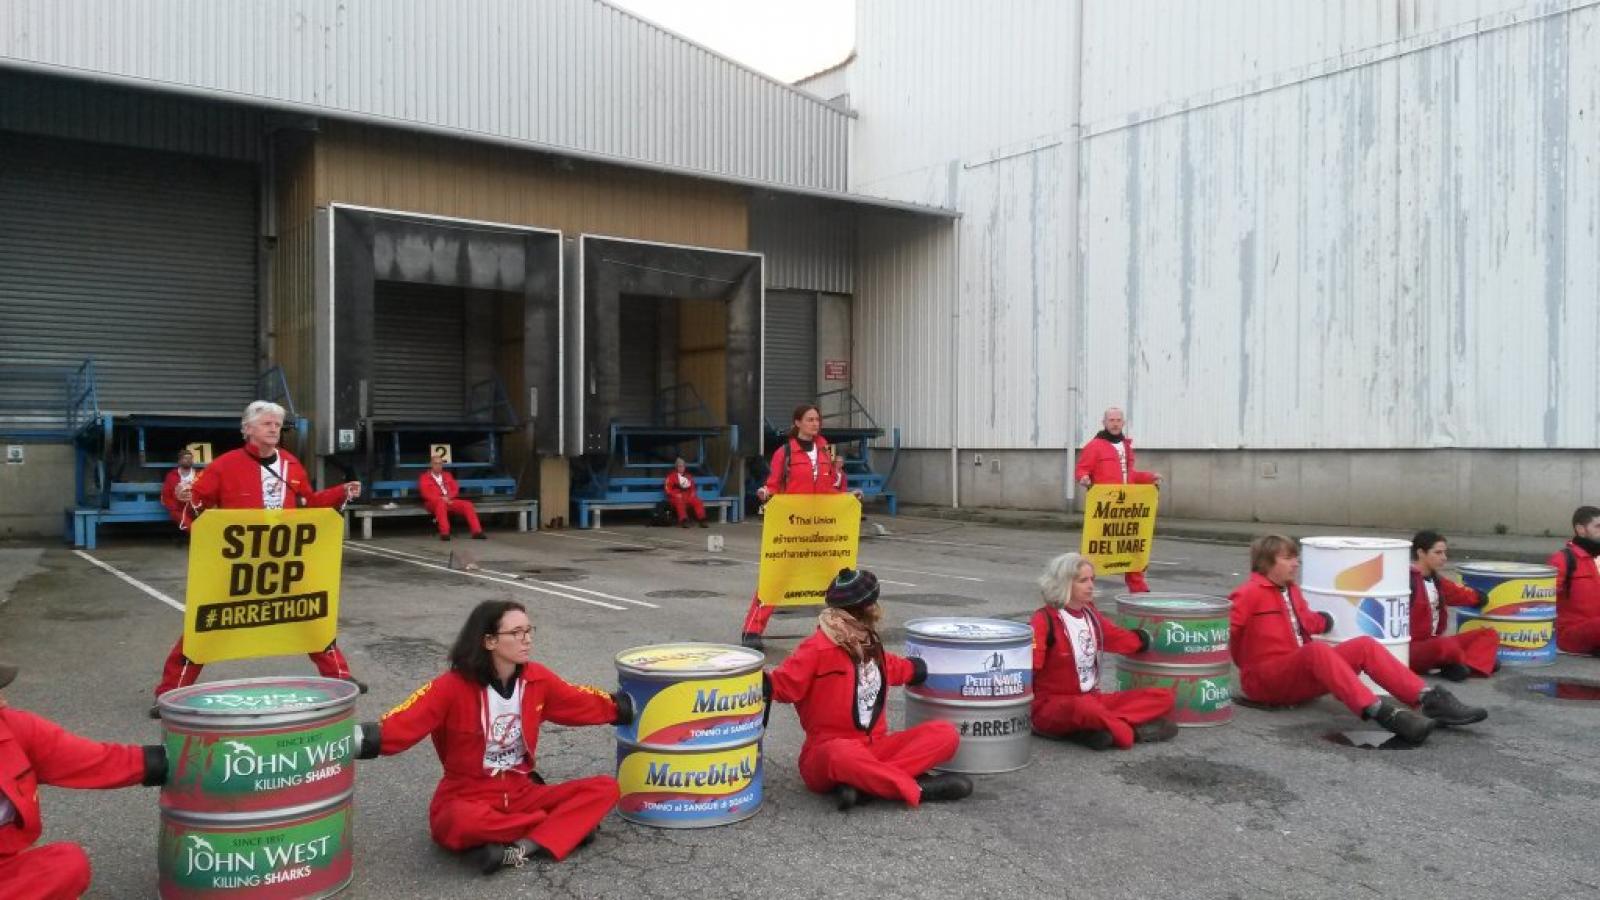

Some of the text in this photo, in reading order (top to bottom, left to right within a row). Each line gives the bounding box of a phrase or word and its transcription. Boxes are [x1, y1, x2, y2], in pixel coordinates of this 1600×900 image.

[193, 444, 205, 463] 1
[435, 446, 448, 464] 2
[1102, 522, 1140, 537] KILLER
[222, 523, 317, 559] STOP
[1089, 539, 1146, 554] DEL MARE
[230, 561, 305, 597] DCP
[205, 597, 321, 628] #ARRÊTHON
[1386, 598, 1409, 617] Tha
[1166, 629, 1209, 646] JOHN
[221, 735, 351, 784] JOHN WEST
[254, 764, 341, 791] KILLING SHARKS
[645, 761, 739, 787] Mareblu
[644, 801, 673, 812] TONNO
[684, 801, 718, 812] SANGUE
[232, 837, 261, 847] SINCE
[186, 835, 331, 876] JOHN WEST
[213, 865, 312, 888] KILLING SHARKS
